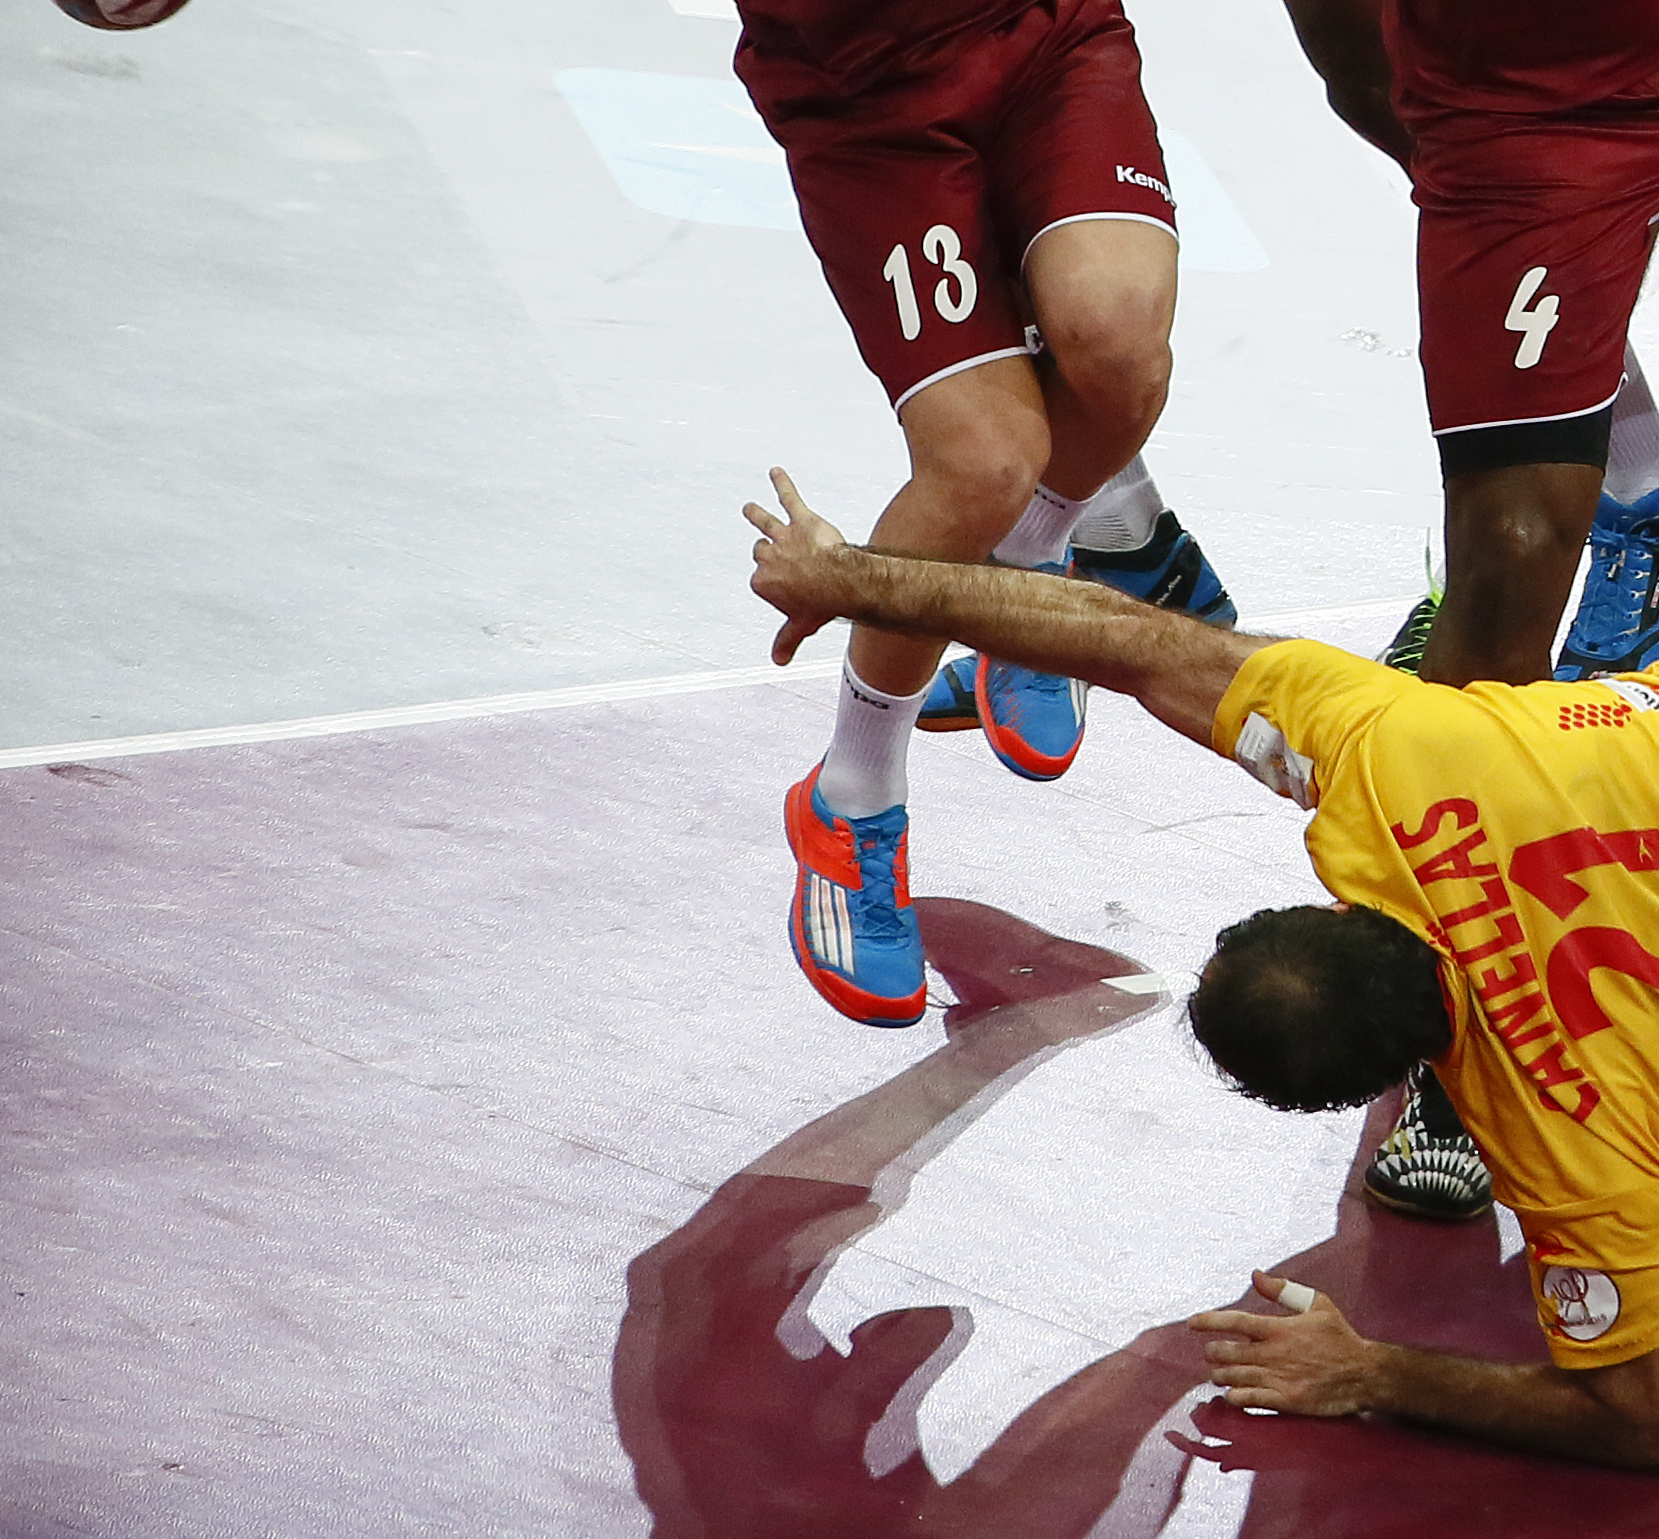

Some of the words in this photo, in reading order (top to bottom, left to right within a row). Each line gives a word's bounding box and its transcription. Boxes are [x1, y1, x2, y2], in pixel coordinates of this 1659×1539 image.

[1115, 164, 1175, 207] Kemp
[883, 224, 978, 341] 13
[1504, 266, 1560, 370] 4
